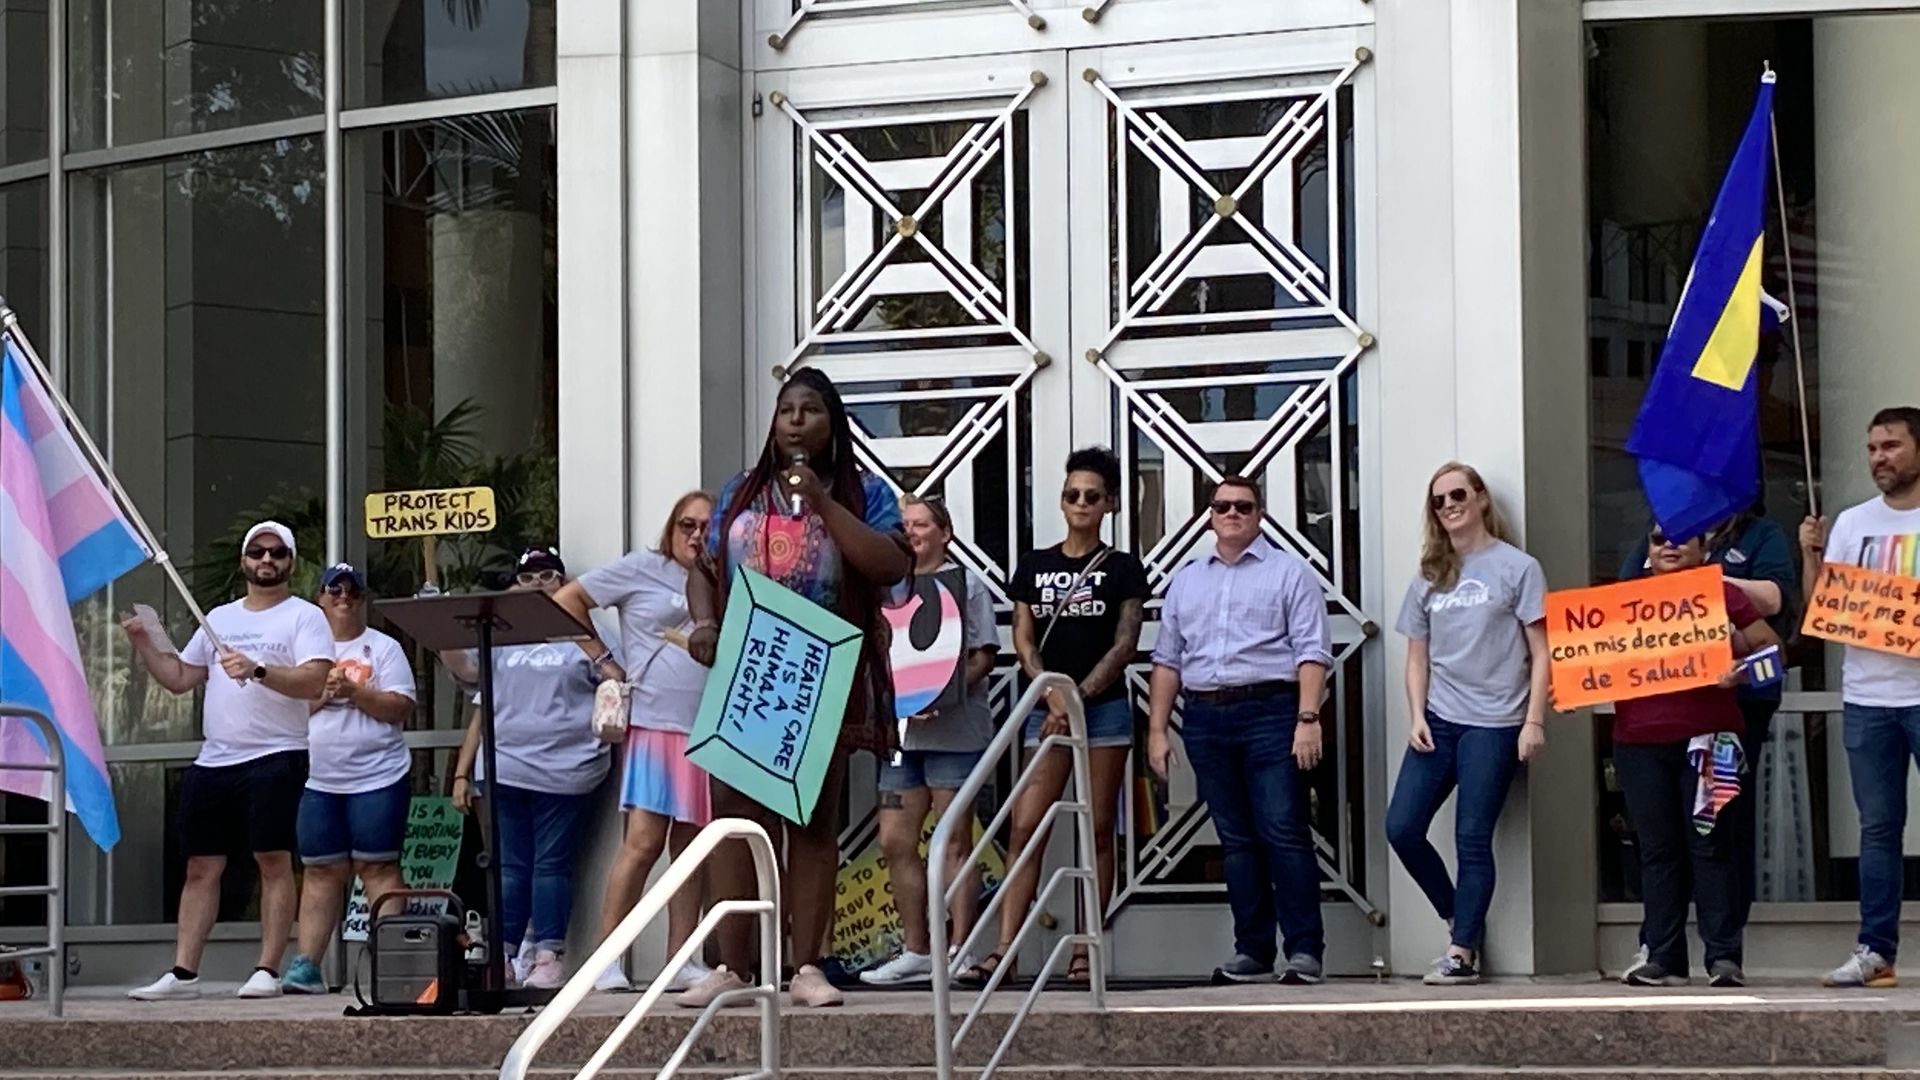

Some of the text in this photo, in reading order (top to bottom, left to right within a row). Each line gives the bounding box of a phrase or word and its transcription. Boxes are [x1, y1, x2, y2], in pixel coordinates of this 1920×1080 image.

[384, 491, 476, 513] PROTECT
[369, 508, 490, 534] TRANS KIDS
[1861, 577, 1904, 601] vida
[1565, 593, 1709, 633] NO JODAS
[1874, 605, 1906, 626] me
[1552, 623, 1729, 662] con mis derechos
[728, 637, 767, 733] RIGHT!
[752, 626, 791, 721] HUMAN
[773, 660, 799, 712] IS A
[1581, 666, 1613, 691] de
[773, 642, 824, 771] HEALTH CARE
[411, 803, 446, 820] IS A
[852, 867, 873, 885] TO
[834, 887, 875, 922] ROUP
